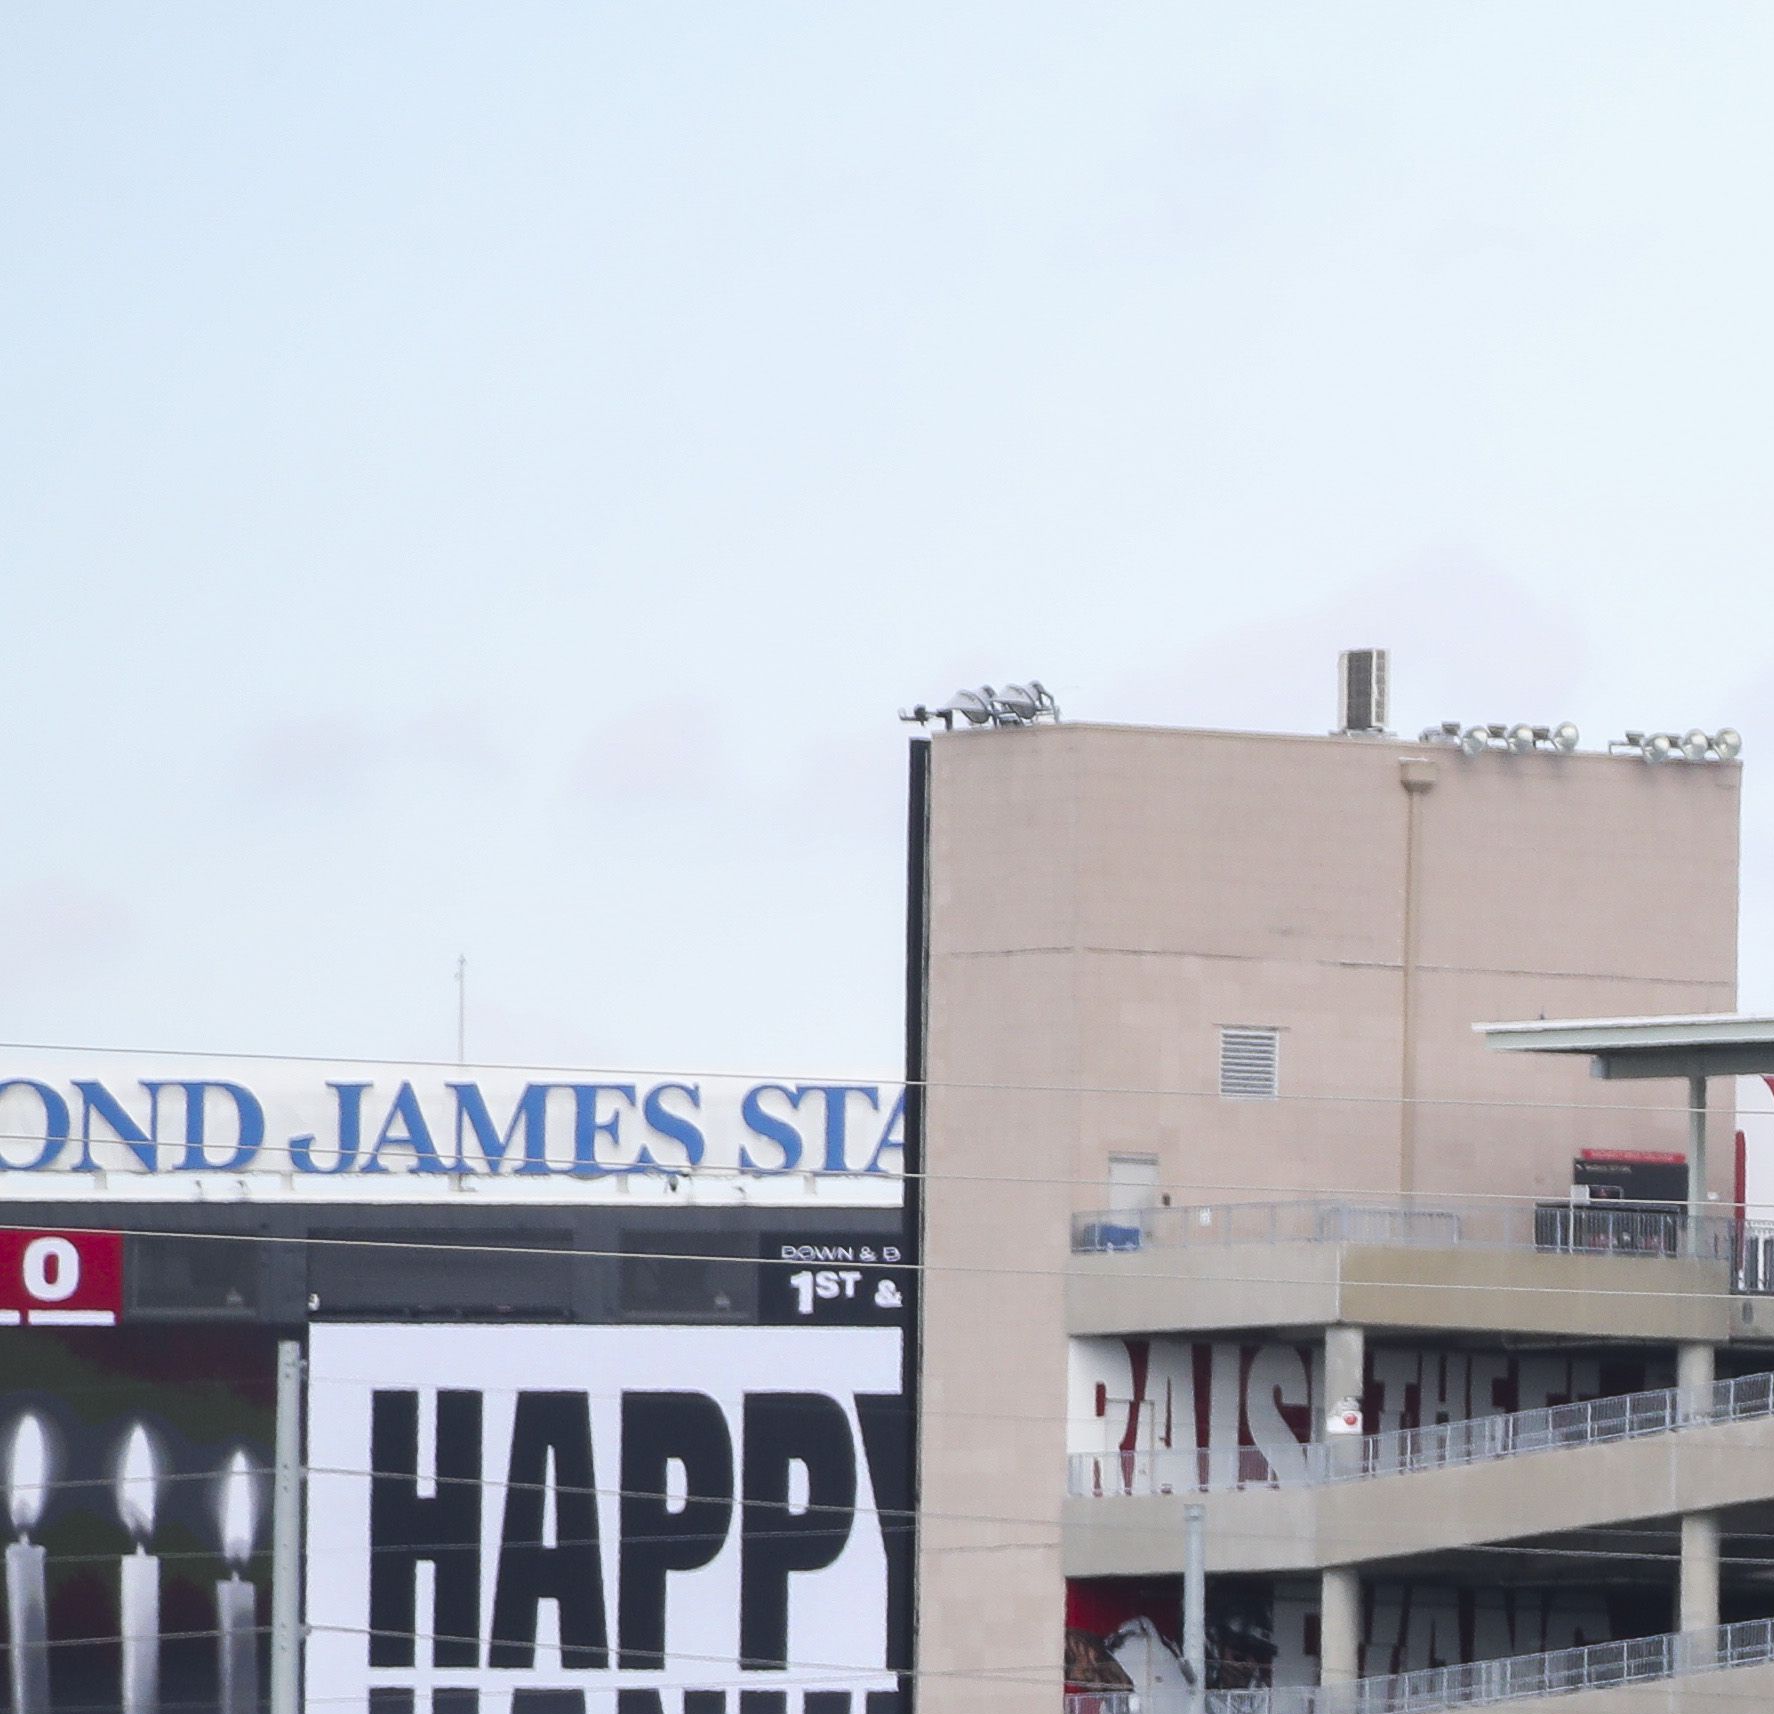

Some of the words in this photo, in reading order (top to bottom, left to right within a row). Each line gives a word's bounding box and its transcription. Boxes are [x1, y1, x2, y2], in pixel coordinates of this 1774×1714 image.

[289, 1079, 706, 1177] JAMES
[781, 1245, 853, 1261] DOWN
[860, 1246, 878, 1262] &
[790, 1270, 862, 1314] 1ST
